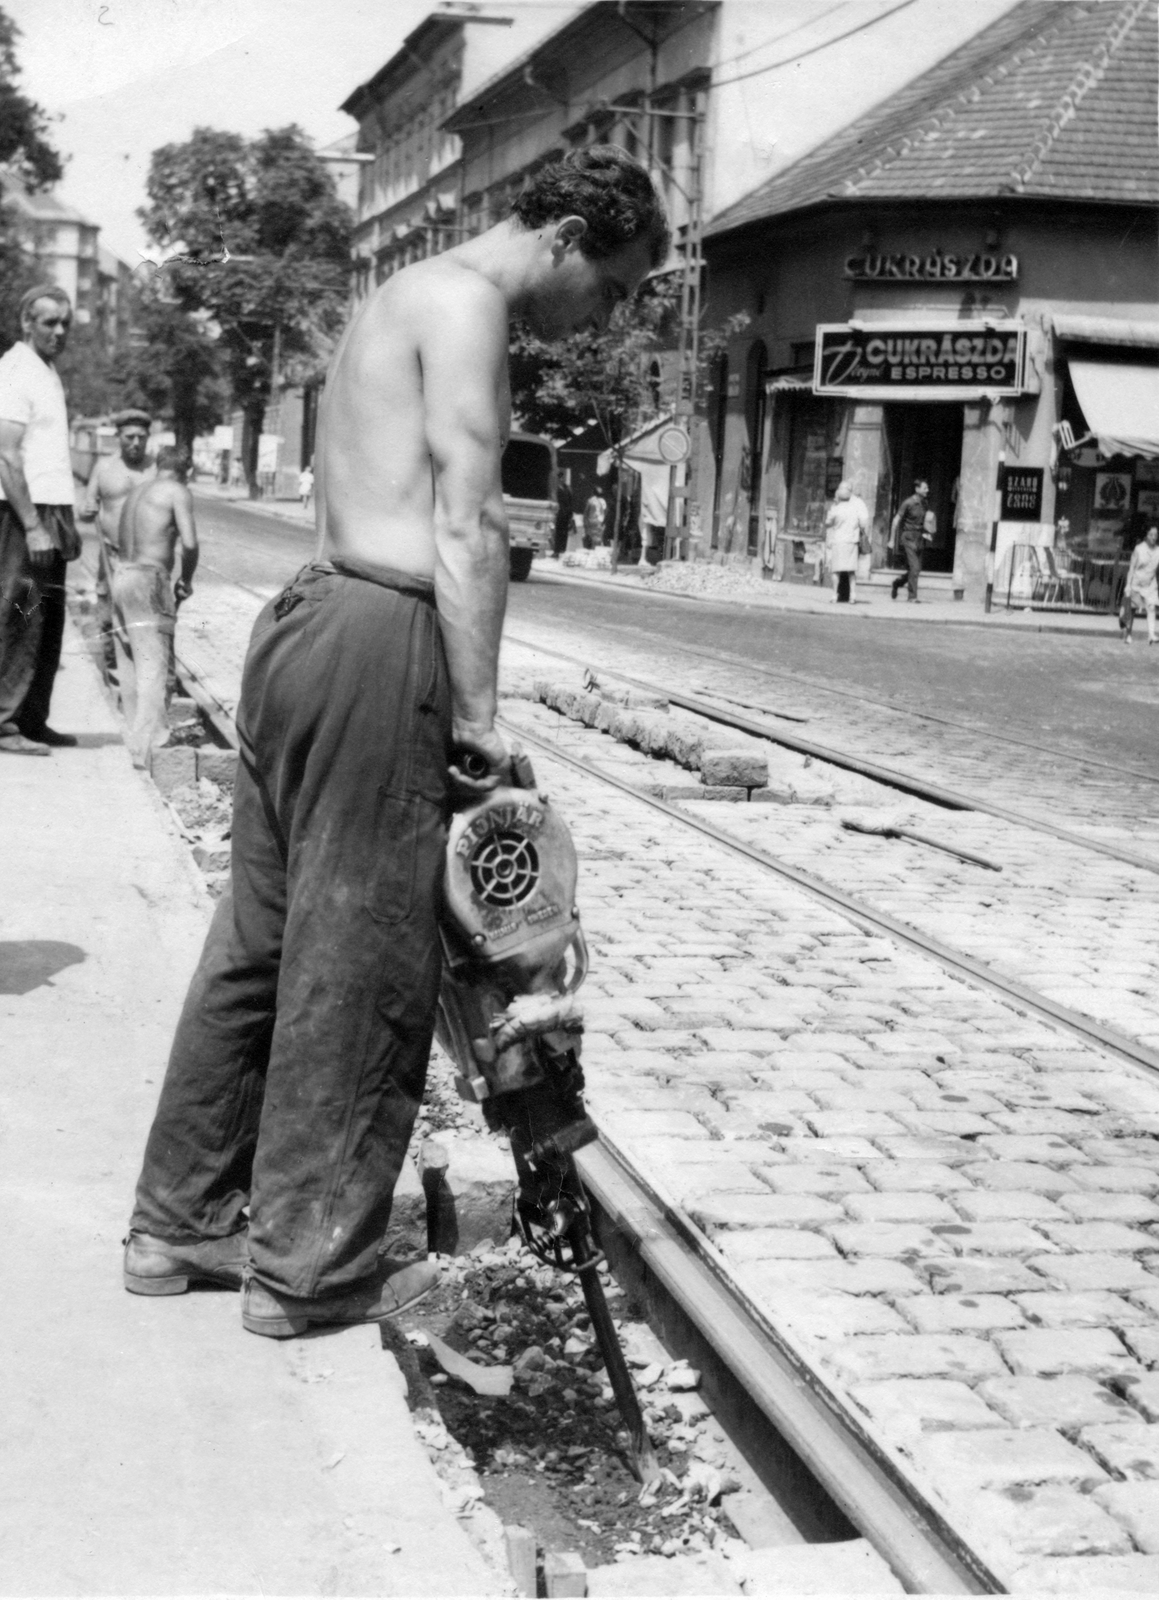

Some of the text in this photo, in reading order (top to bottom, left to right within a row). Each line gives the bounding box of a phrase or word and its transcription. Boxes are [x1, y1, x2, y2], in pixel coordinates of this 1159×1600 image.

[845, 250, 1018, 279] CUKRÁSZDA
[865, 334, 1017, 365] CUKRÁSZDA
[890, 366, 1006, 380] ESPRESSO
[456, 801, 543, 857] PIONJÄR
